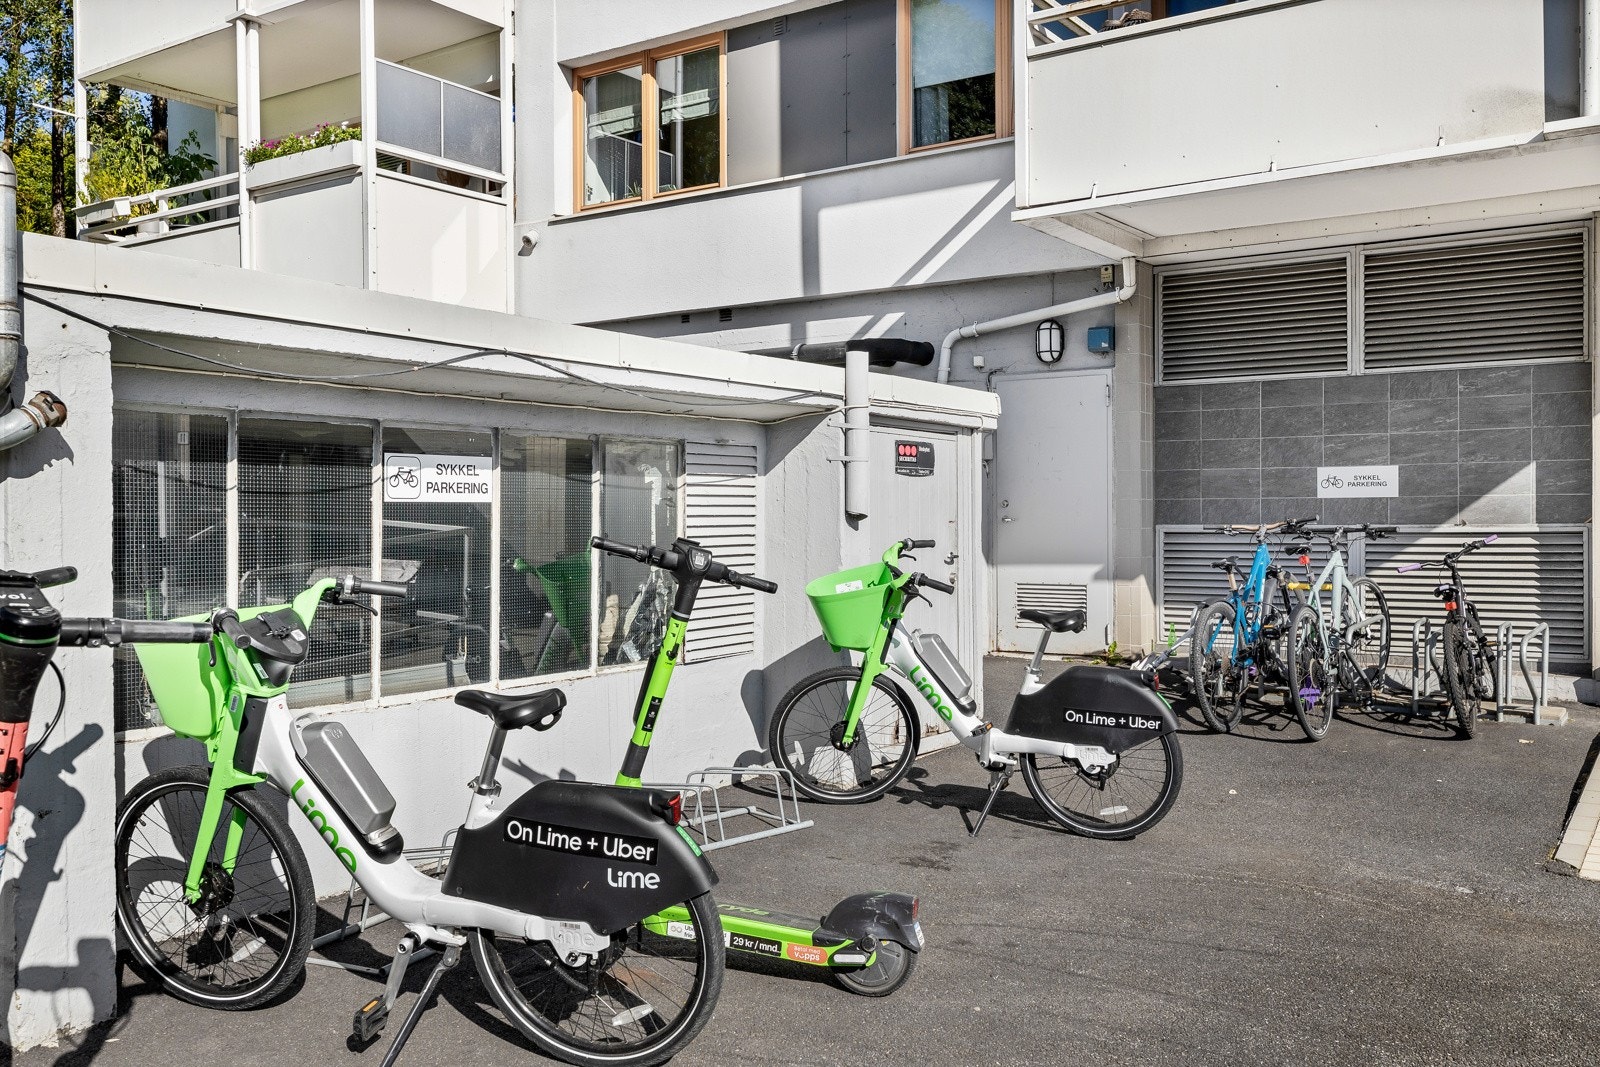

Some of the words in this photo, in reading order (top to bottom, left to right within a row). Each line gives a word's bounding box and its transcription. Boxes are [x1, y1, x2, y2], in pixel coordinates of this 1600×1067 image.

[436, 463, 480, 476] SYKKEL
[426, 481, 489, 494] PARKERING
[909, 665, 953, 721] Lime
[1065, 710, 1083, 723] On
[1085, 712, 1116, 726] Lime
[1118, 717, 1127, 725] +
[1128, 716, 1161, 730] Uber
[291, 778, 357, 873] Lime
[507, 820, 533, 843] On
[536, 825, 582, 851] Lime
[586, 837, 598, 850] +
[603, 836, 655, 861] Uber
[607, 867, 660, 889] Lime
[733, 936, 744, 946] 29
[744, 938, 754, 948] kr
[759, 942, 780, 953] mnd.
